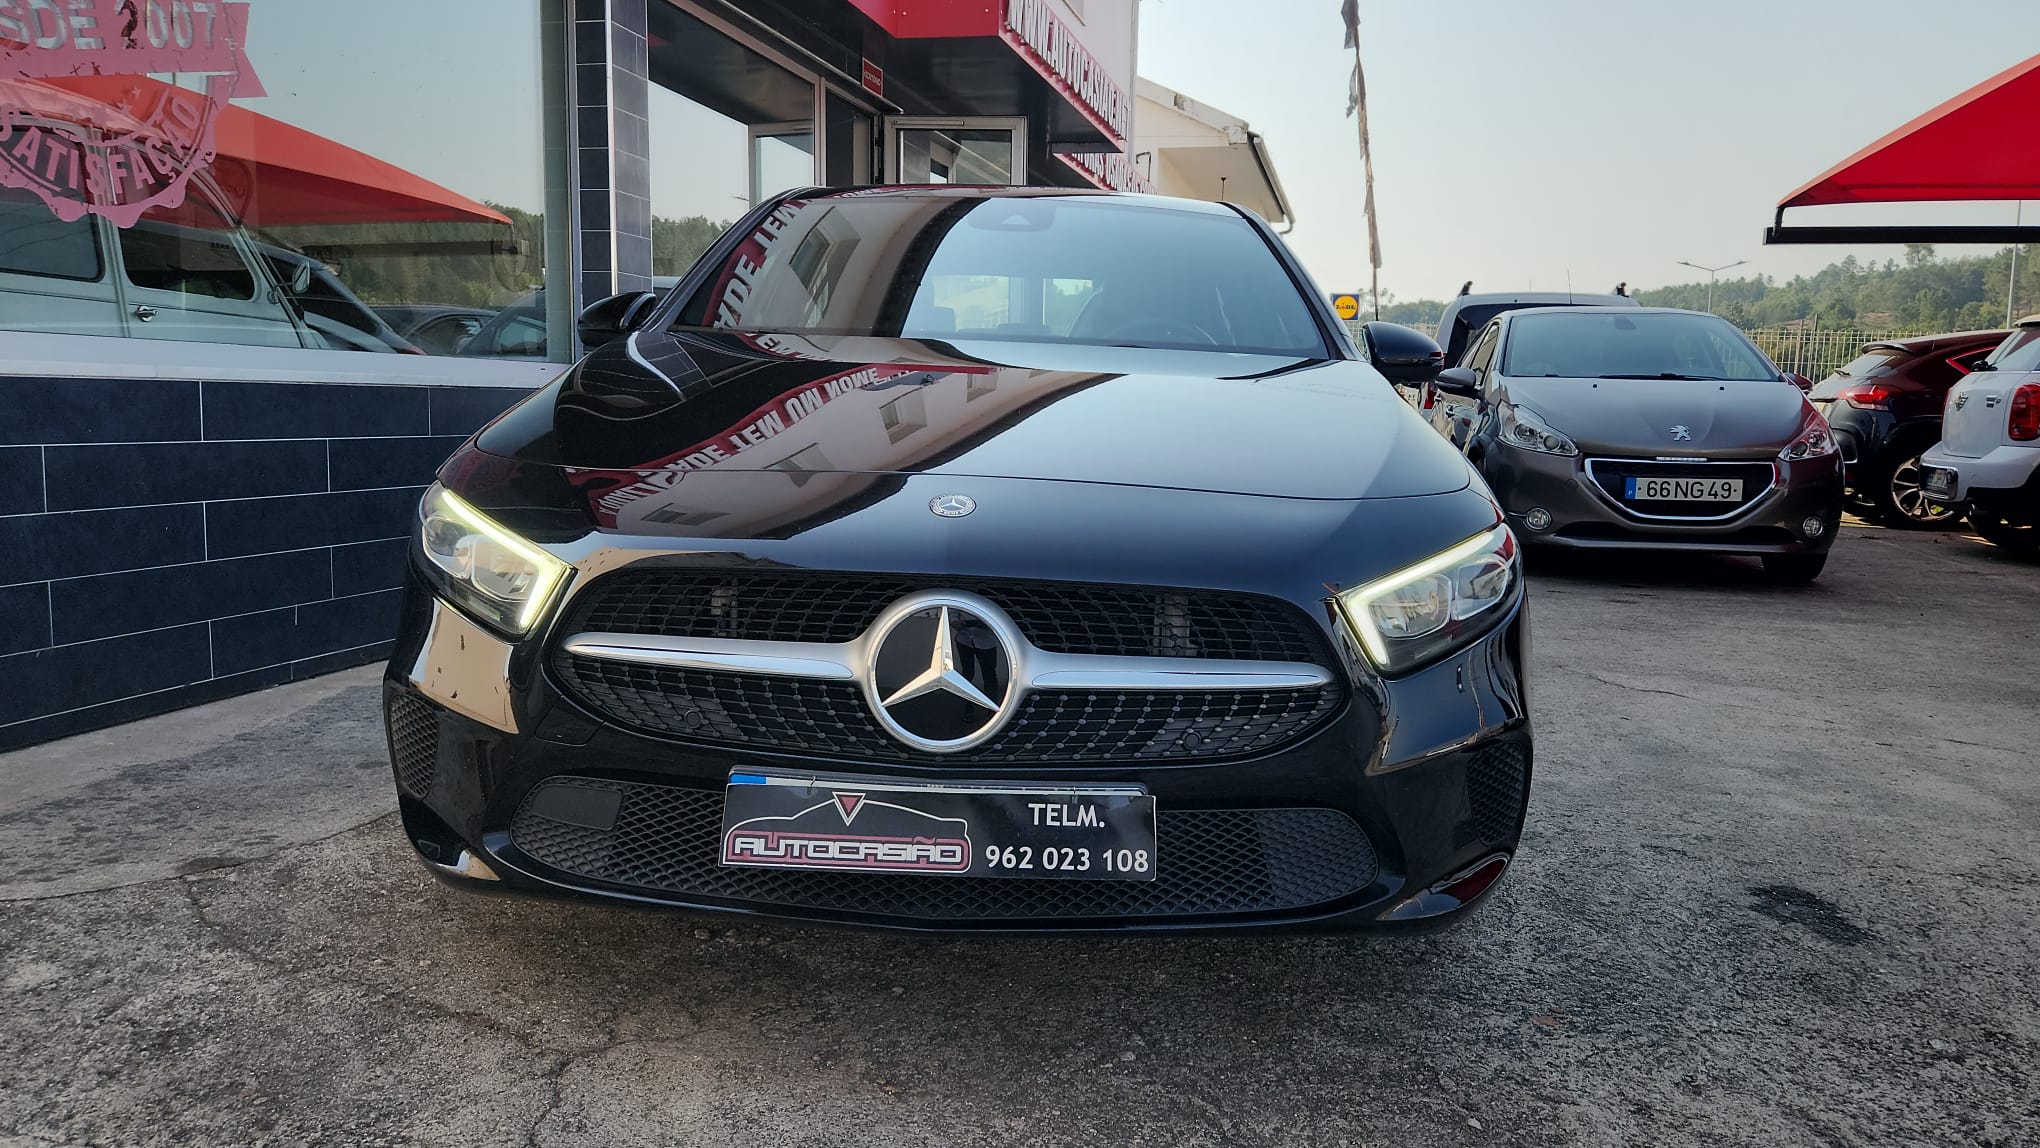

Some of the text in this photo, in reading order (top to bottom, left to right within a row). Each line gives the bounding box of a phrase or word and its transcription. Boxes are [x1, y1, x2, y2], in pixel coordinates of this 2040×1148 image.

[114, 0, 216, 49] 2007
[1028, 803, 1106, 828] TELM.
[734, 836, 962, 863] AUTOCASIÃO
[985, 845, 1149, 872] 962 023 108
